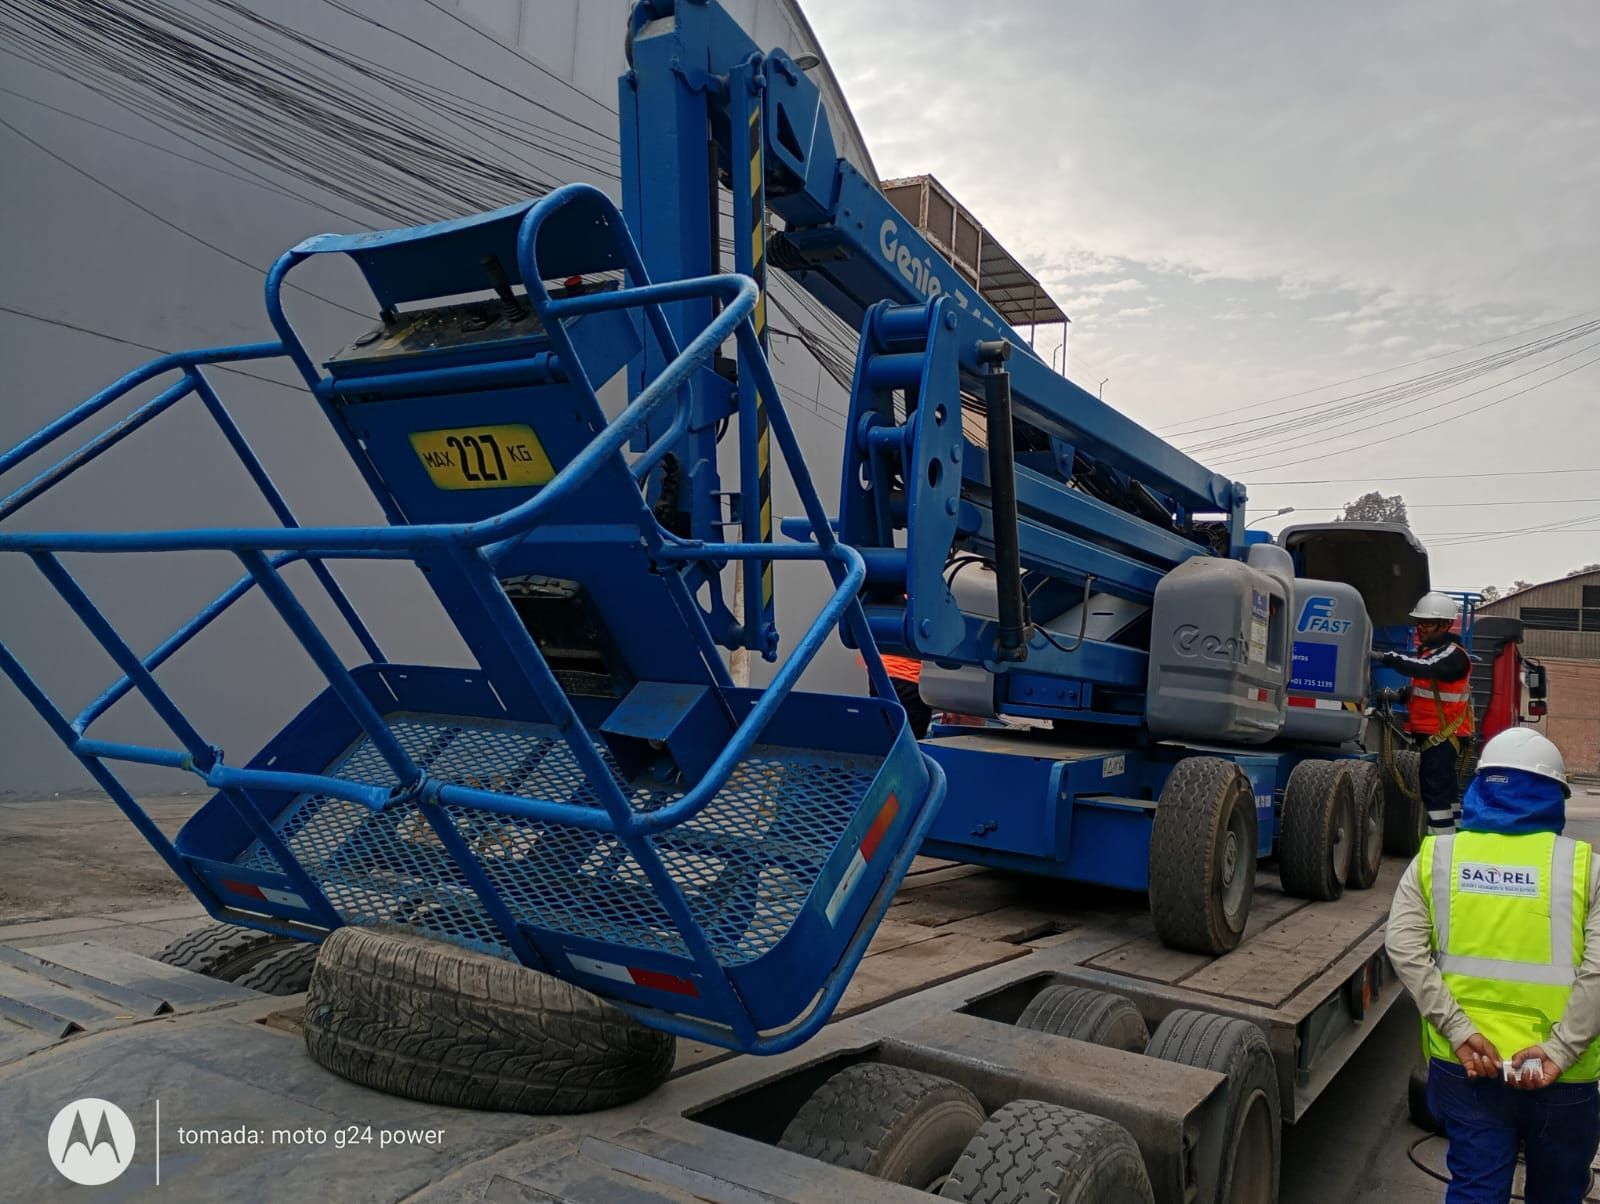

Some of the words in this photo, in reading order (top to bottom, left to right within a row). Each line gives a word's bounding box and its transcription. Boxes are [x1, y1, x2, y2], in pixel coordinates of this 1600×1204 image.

[880, 219, 942, 299] Genie
[423, 451, 455, 468] MAX
[446, 434, 507, 481] 227
[506, 445, 532, 462] KG
[1310, 618, 1351, 634] FAST
[1461, 868, 1535, 885] SATREL
